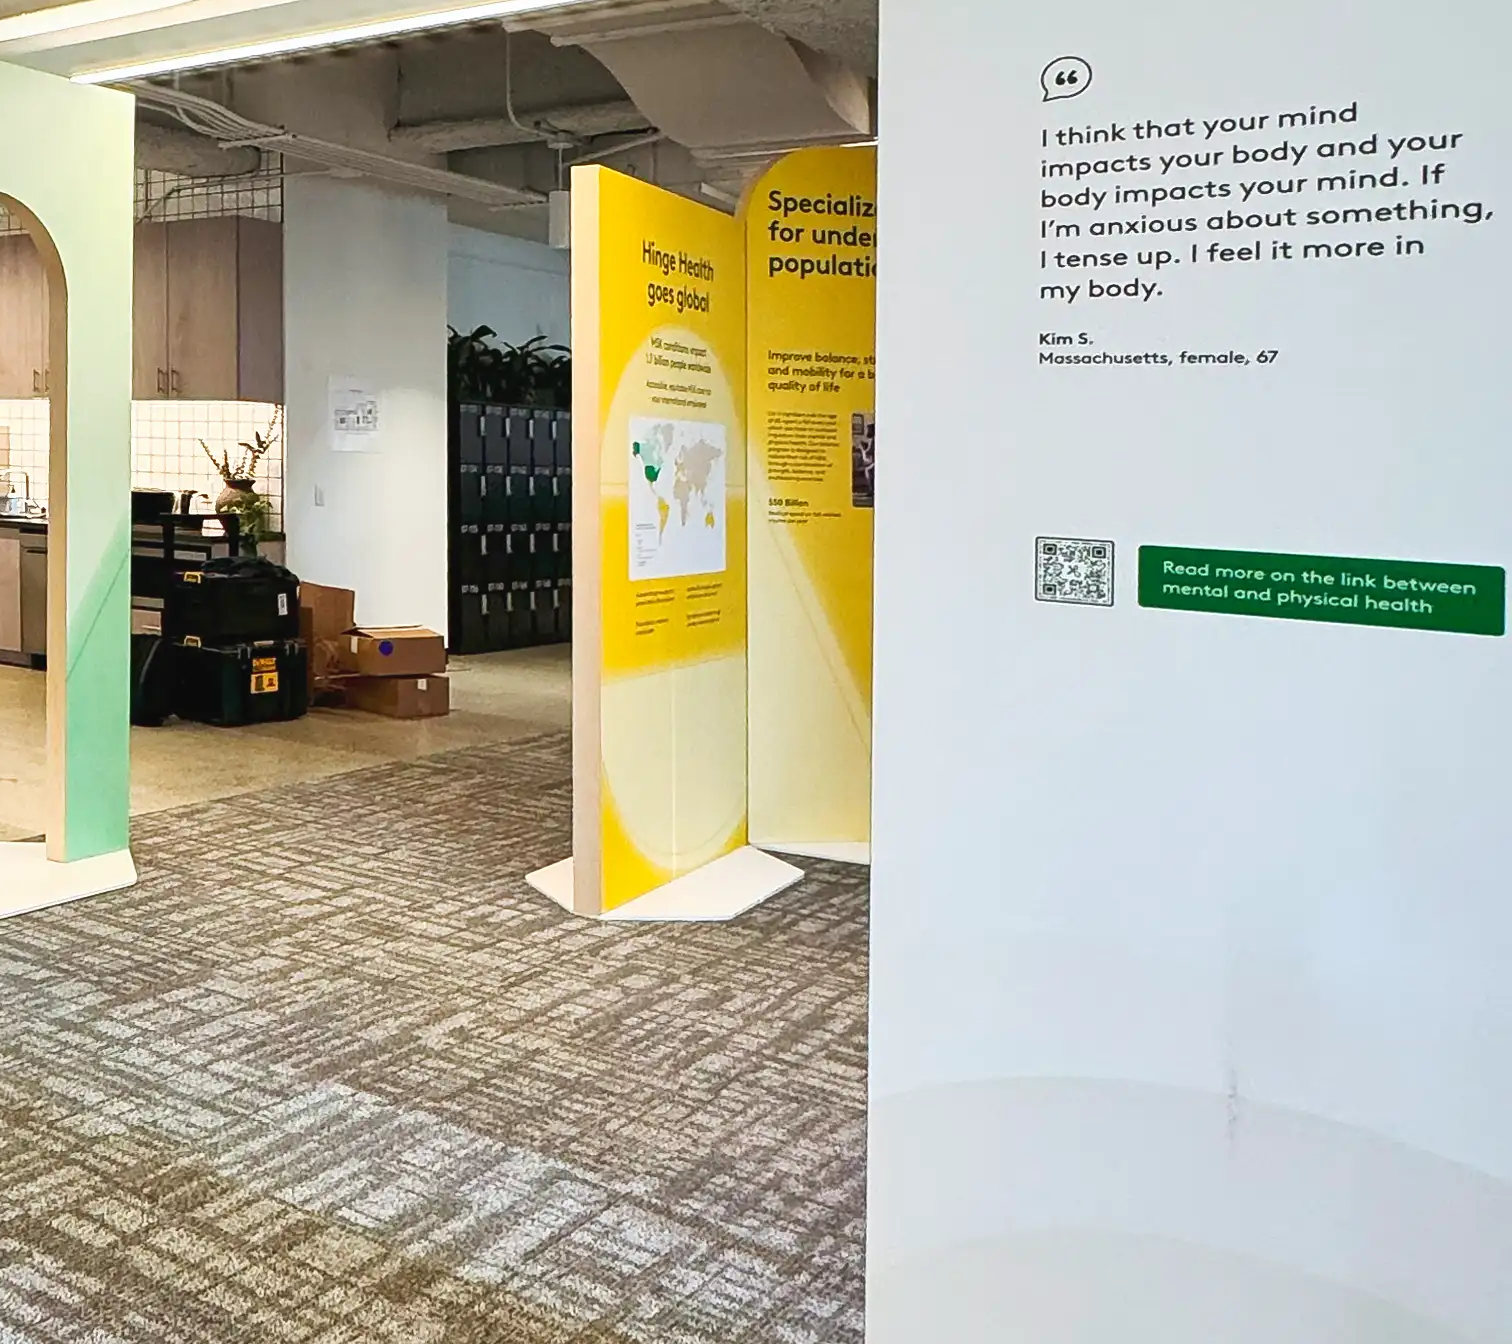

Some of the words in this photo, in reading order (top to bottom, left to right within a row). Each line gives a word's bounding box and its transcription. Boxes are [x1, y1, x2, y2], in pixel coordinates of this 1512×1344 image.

[1042, 129, 1047, 147] I
[1055, 123, 1126, 146] think
[1132, 118, 1195, 139] that
[1203, 115, 1270, 140] your
[1278, 101, 1357, 128] mind
[1041, 155, 1151, 180] impacts
[1159, 152, 1224, 175] your
[1233, 140, 1308, 166] body
[1317, 133, 1377, 158] and
[1387, 133, 1463, 159] your
[1041, 187, 1107, 211] body
[1115, 181, 1231, 207] impacts
[1239, 178, 1308, 202] your
[1317, 166, 1409, 191] mind.
[1422, 163, 1445, 185] If
[768, 190, 876, 217] Specializ
[1041, 220, 1080, 238] I'm
[1089, 215, 1197, 236] anxious
[1207, 209, 1297, 230] about
[1306, 199, 1493, 225] something,
[768, 220, 805, 243] for
[642, 240, 676, 274] Hinge
[678, 251, 714, 283] Health
[1041, 250, 1046, 269] I
[1053, 252, 1128, 268] tense
[1137, 251, 1180, 270] up.
[1192, 244, 1197, 263] I
[1206, 240, 1260, 262] feel
[1272, 240, 1293, 260] it
[1303, 242, 1385, 259] more
[1396, 235, 1424, 255] in
[648, 283, 674, 307] goes
[676, 284, 710, 314] global
[1040, 285, 1081, 304] my
[1089, 277, 1163, 302] body.
[1039, 333, 1073, 345] Kim
[1078, 332, 1094, 345] S.
[768, 350, 813, 365] Improve
[1039, 352, 1173, 366] Massachusetts,
[1179, 350, 1250, 366] female,
[1256, 350, 1279, 364] 67
[768, 366, 789, 375] and
[792, 366, 838, 380] mobility
[839, 367, 855, 380] for
[768, 380, 807, 394] quality
[809, 381, 821, 392] of
[822, 379, 841, 393] life
[1163, 560, 1209, 576] Read
[1215, 568, 1266, 580] more
[1270, 571, 1295, 582] on
[1301, 570, 1335, 585] the
[1341, 572, 1376, 588] link
[1383, 575, 1476, 595] between
[1163, 584, 1228, 598] mental
[1234, 588, 1271, 601] and
[1277, 589, 1358, 608] physical
[1365, 595, 1432, 614] health
